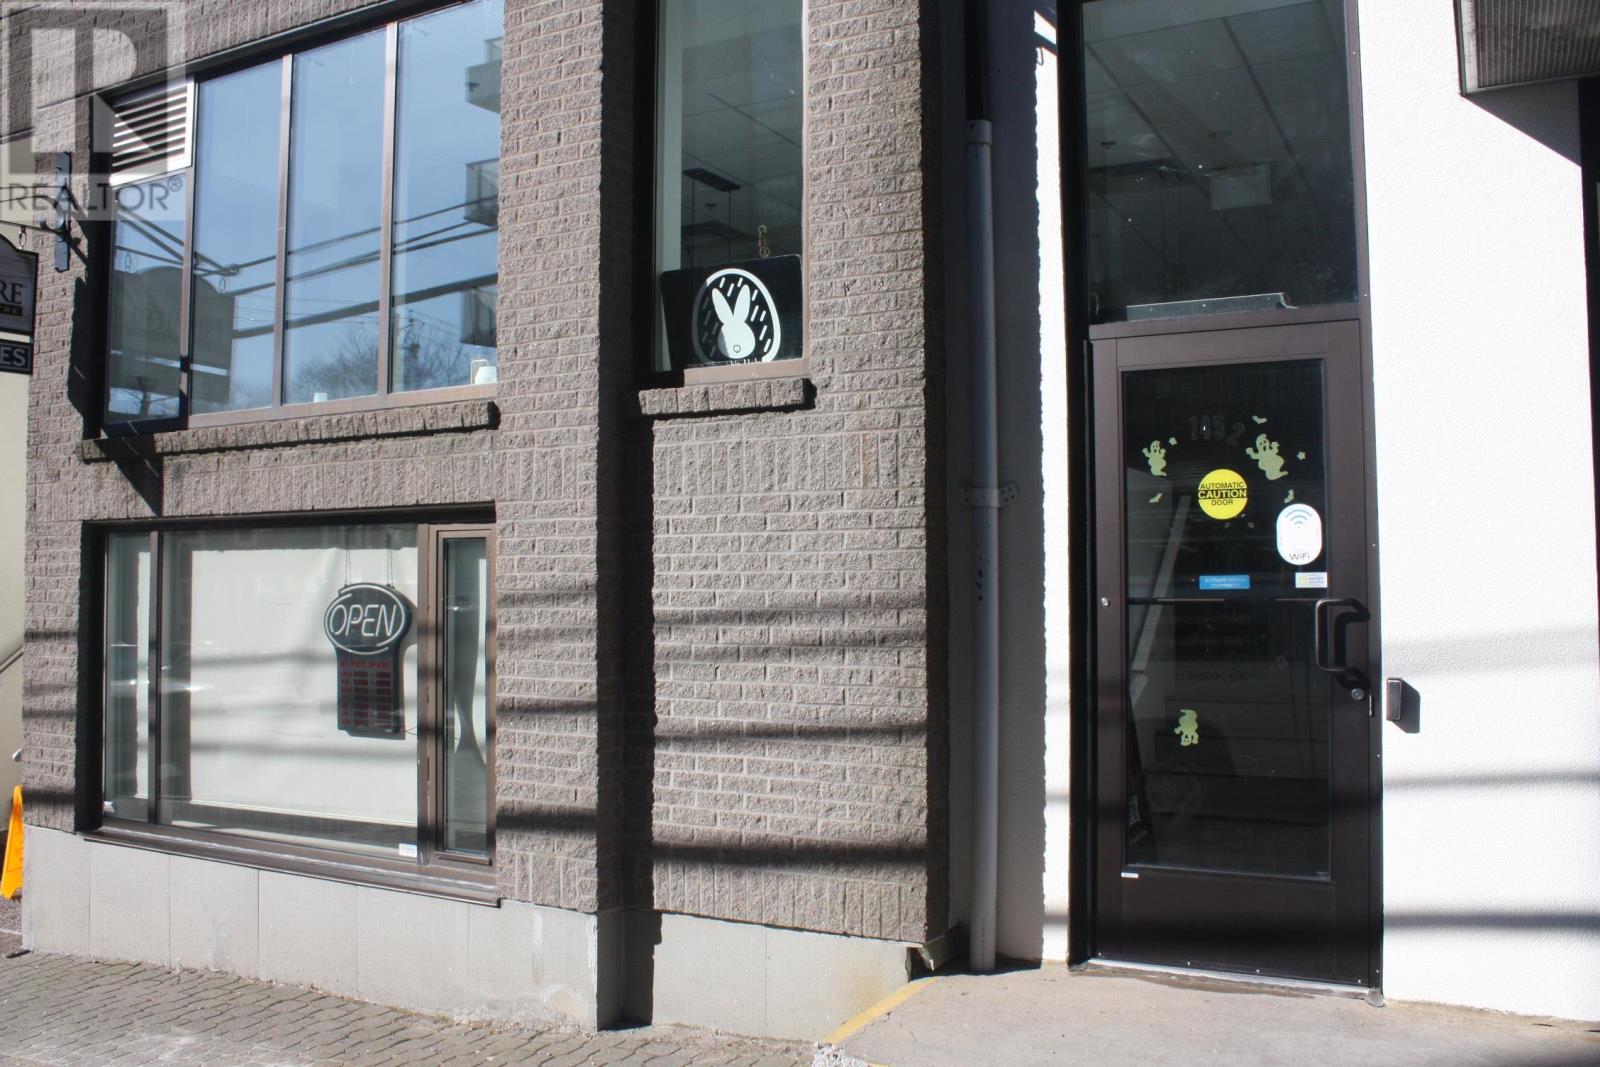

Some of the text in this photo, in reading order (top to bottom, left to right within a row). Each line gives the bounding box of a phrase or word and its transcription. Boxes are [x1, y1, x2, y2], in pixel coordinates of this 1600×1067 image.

[0, 346, 27, 368] ES
[1200, 481, 1244, 490] AUTOMATIC
[1198, 489, 1247, 499] CAUTION
[1211, 498, 1234, 506] DOOR
[329, 603, 397, 637] OPEN
